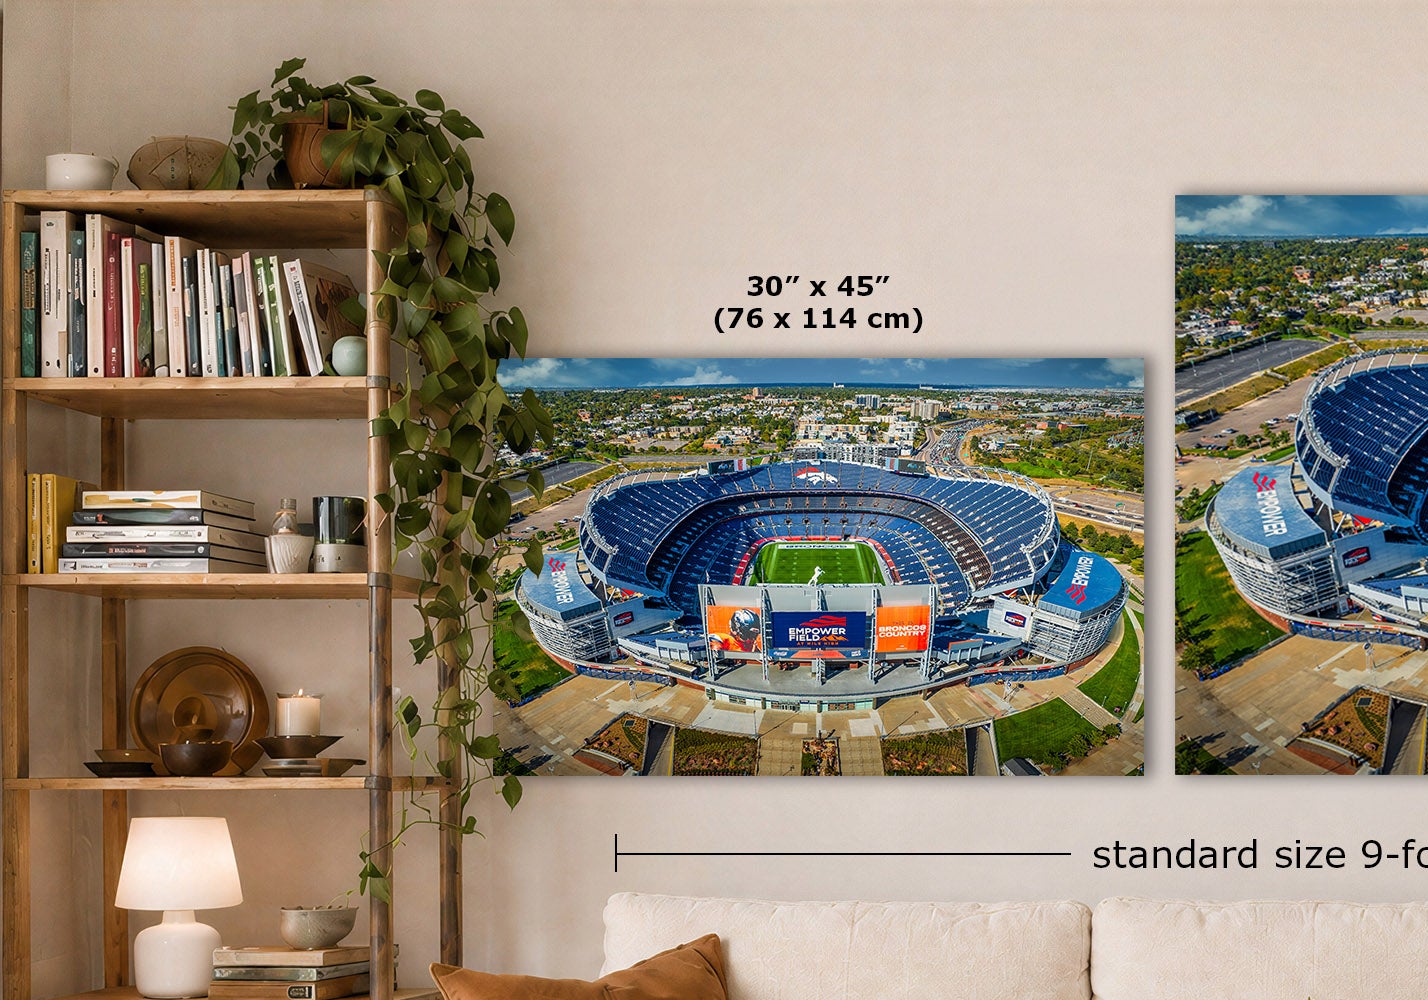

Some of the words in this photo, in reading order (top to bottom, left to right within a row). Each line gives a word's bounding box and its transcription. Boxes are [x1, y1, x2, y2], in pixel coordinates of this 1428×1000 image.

[1256, 489, 1288, 537] EMPOWER
[1071, 556, 1094, 587] EMPOWER
[551, 570, 574, 605] EMPOWER
[788, 627, 846, 635] EMPOWER
[879, 624, 927, 632] BRONCOS
[879, 630, 926, 638] COUNTRY
